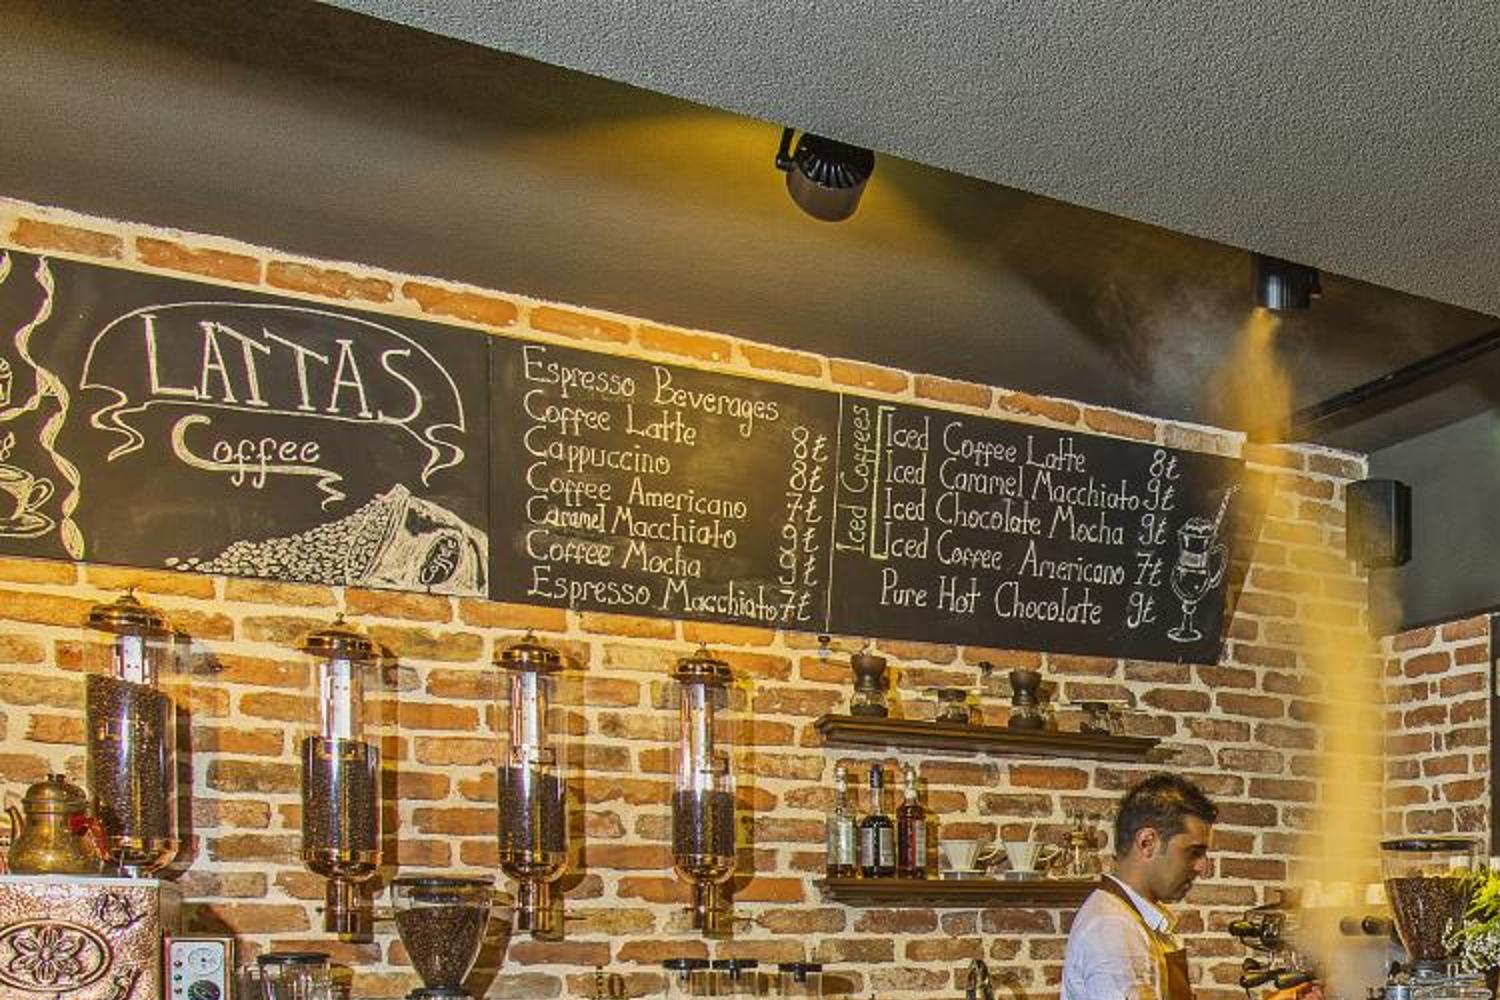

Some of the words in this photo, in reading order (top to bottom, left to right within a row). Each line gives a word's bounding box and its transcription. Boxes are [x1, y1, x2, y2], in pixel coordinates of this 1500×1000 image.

[140, 314, 424, 424] LATTAS
[522, 345, 635, 399] Espresso
[653, 365, 779, 438] Beverages
[523, 389, 611, 436] Coffee
[626, 404, 697, 446] Latte
[885, 413, 929, 451] Iced
[943, 421, 1017, 467] Coffee
[1025, 436, 1087, 473] Latte
[171, 414, 323, 489] Coffee
[523, 425, 671, 474] Cappuccino
[840, 404, 871, 493] Coffees
[526, 461, 611, 506] Coffee
[628, 476, 747, 520] Americano
[884, 449, 927, 485] Iced
[938, 457, 1024, 498] Caramel
[1030, 473, 1140, 512] Macchiato
[525, 494, 605, 533] Caramel
[611, 505, 737, 549] Macchiato
[836, 503, 867, 554] Iced
[883, 488, 925, 522] Iced
[935, 492, 1041, 536] Chocolate
[1048, 505, 1125, 546] Mocha
[525, 529, 612, 567] Coffee
[621, 541, 702, 578] Mocha
[882, 521, 929, 561] Iced
[937, 529, 1002, 571] Coffee
[1017, 542, 1126, 586] Americano
[527, 565, 650, 610] Espresso
[659, 578, 777, 620] Macchiato
[880, 567, 928, 608] Pure
[937, 575, 981, 615] Hot
[994, 581, 1102, 625] Chocolate
